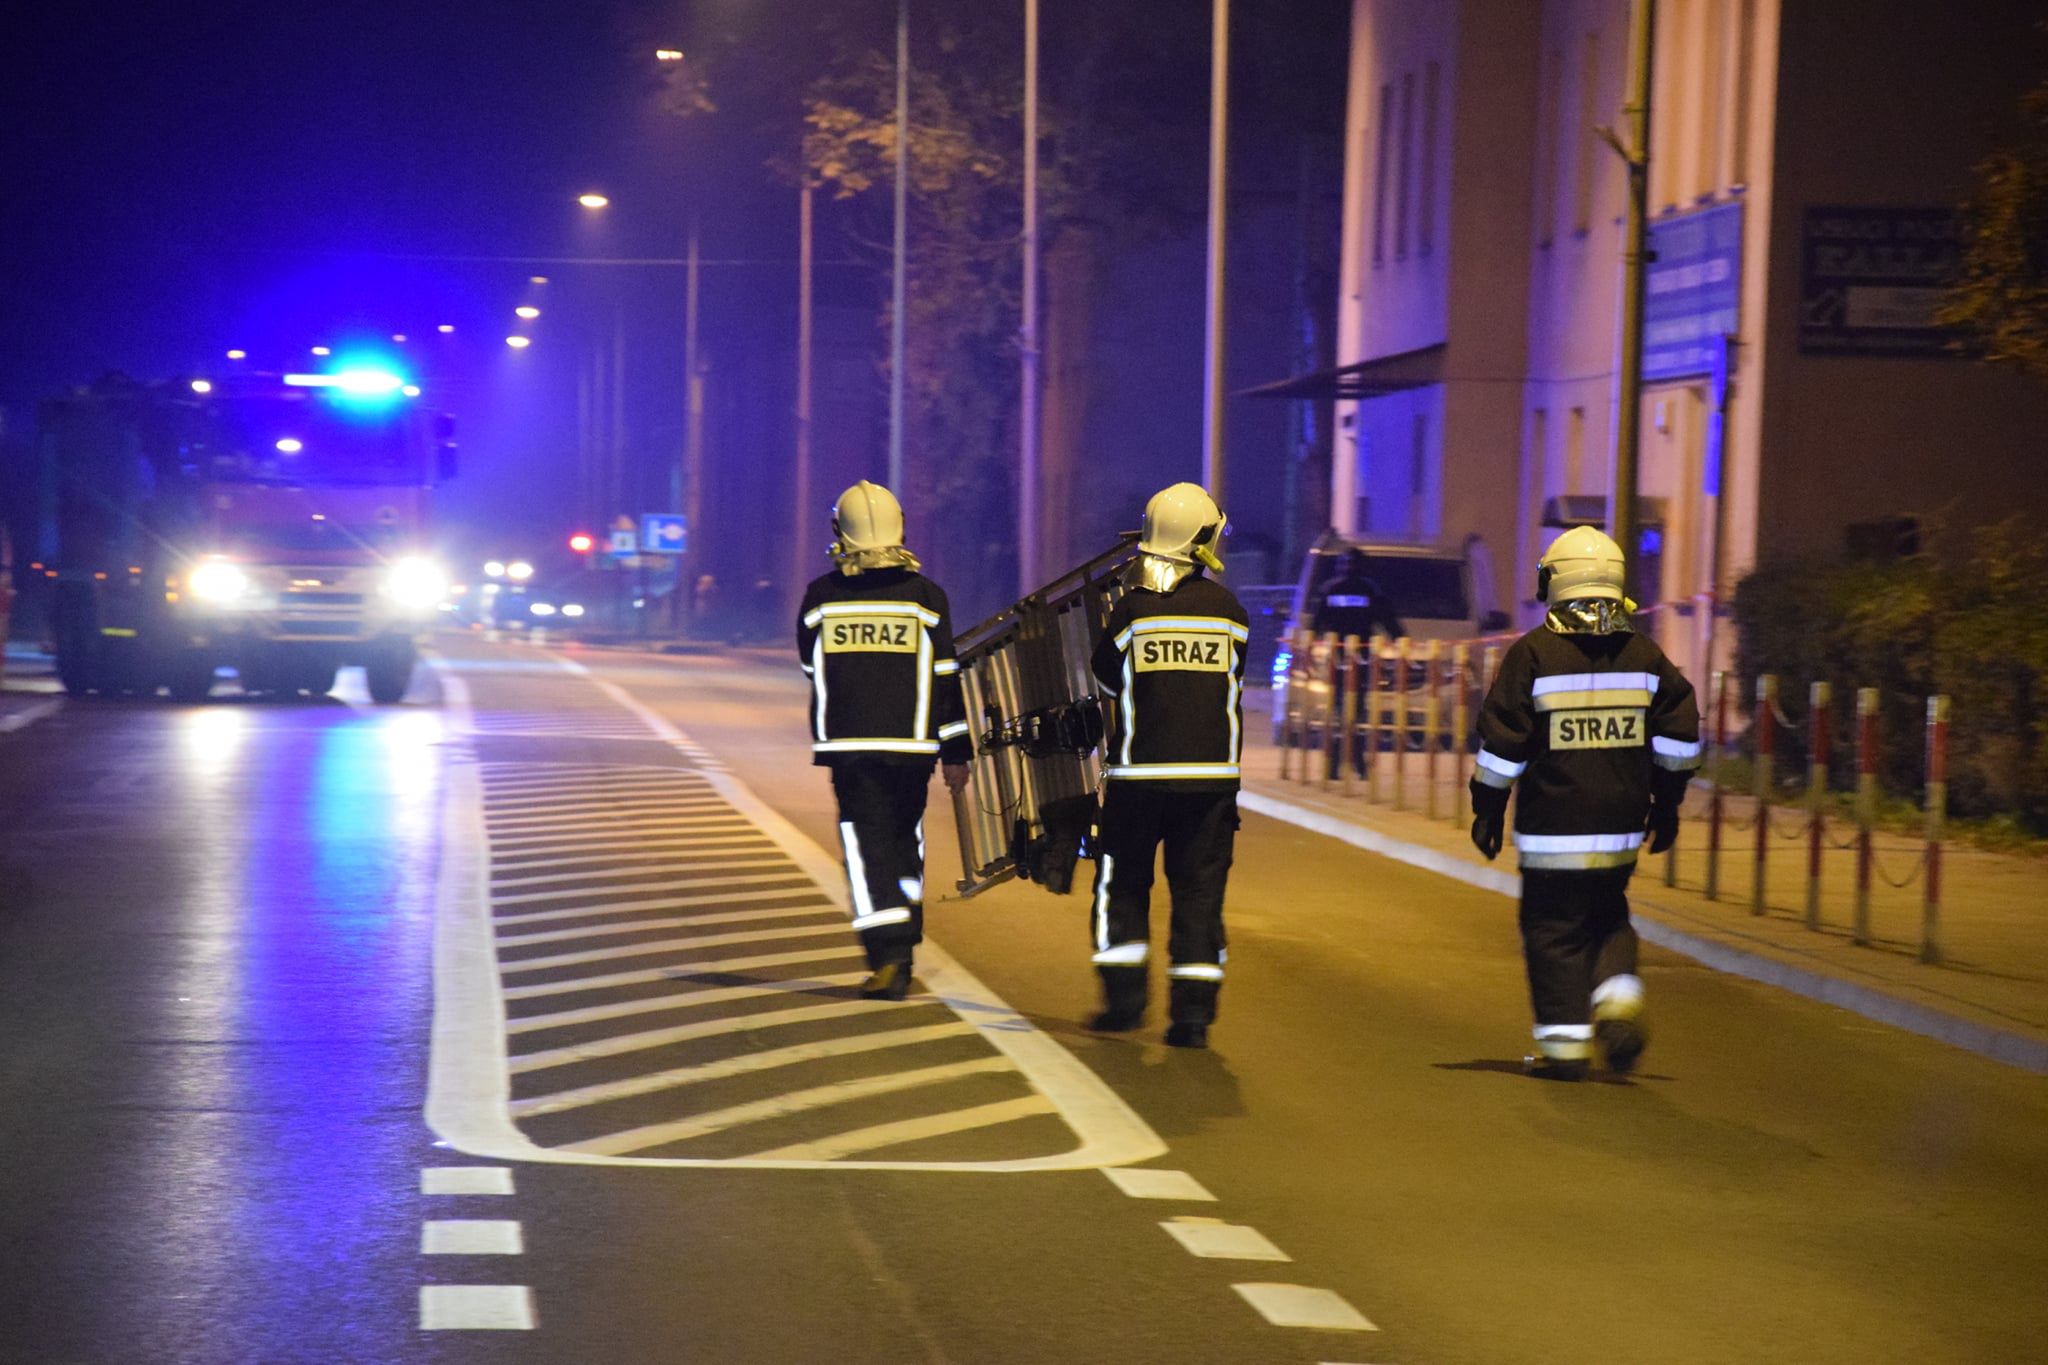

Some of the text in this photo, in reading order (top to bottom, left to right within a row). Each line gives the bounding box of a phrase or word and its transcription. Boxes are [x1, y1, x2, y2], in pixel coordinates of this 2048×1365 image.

[834, 623, 908, 646] STRAZ
[1143, 640, 1220, 664] STRAZ
[1559, 716, 1637, 742] STRAZ
